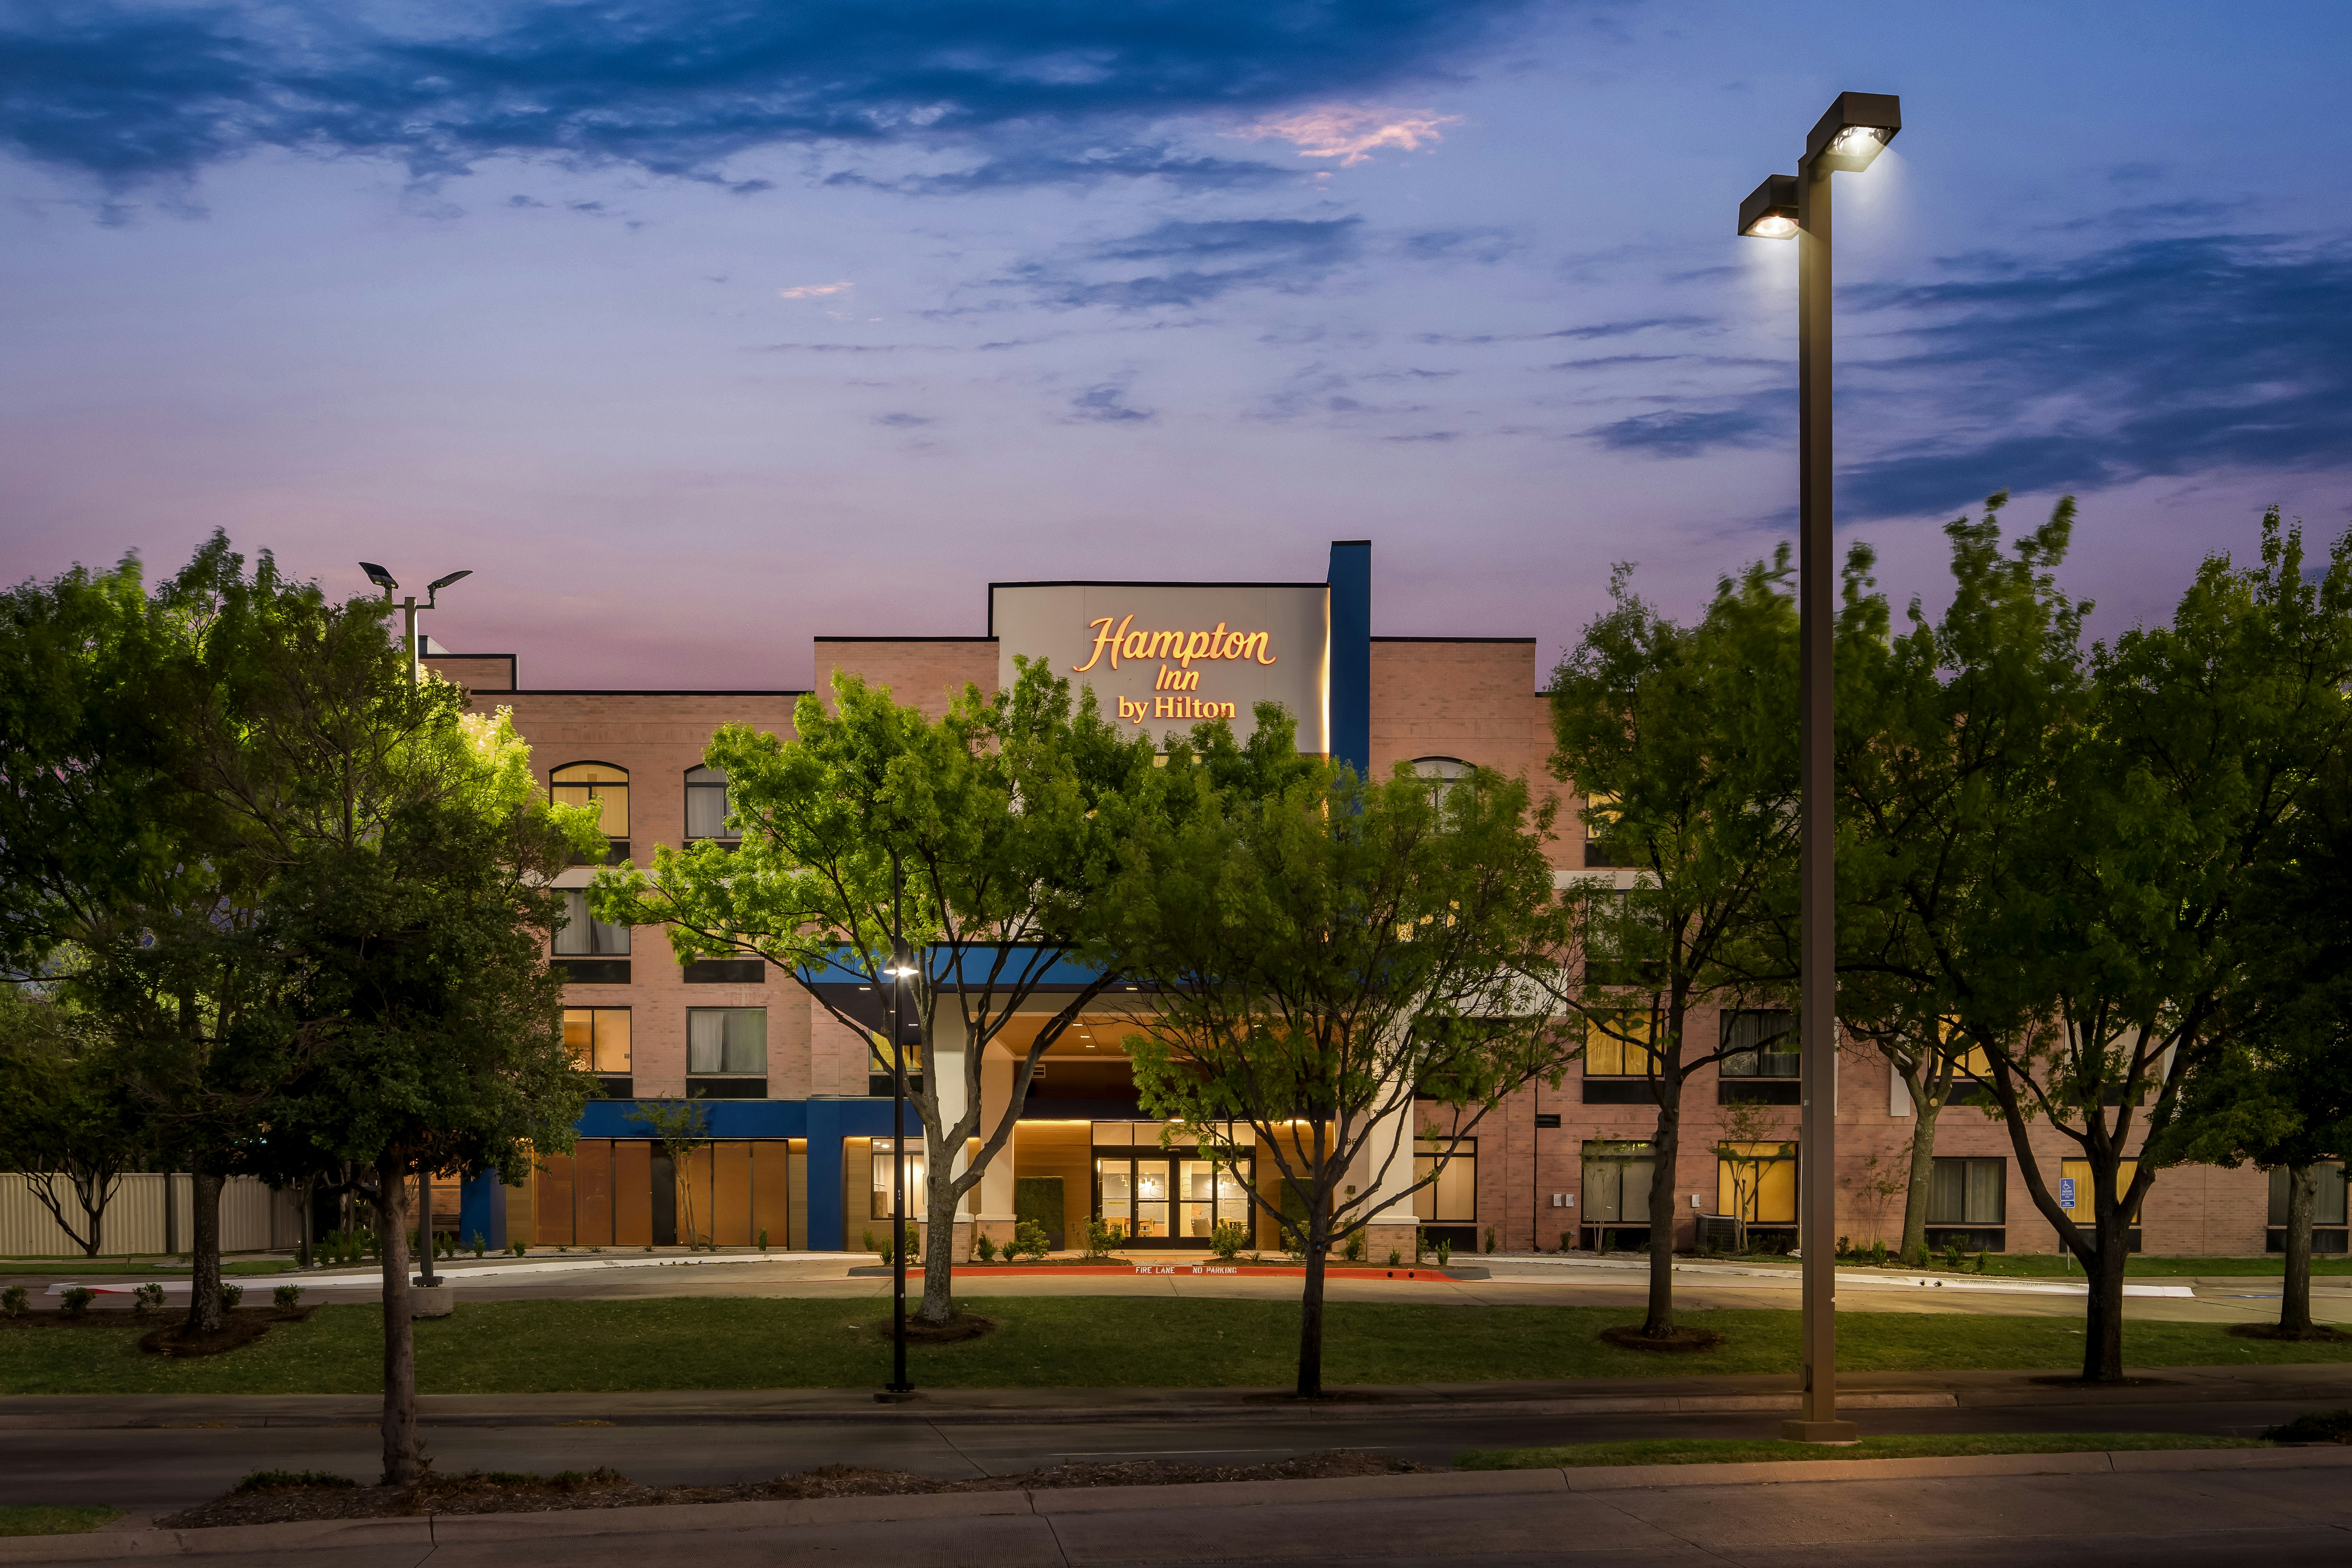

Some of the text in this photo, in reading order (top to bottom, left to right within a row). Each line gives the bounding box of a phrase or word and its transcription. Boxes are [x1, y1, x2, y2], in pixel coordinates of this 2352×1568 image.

[1073, 614, 1276, 672] Hampton
[1156, 664, 1199, 691] Inn
[1118, 695, 1236, 724] by Hilton
